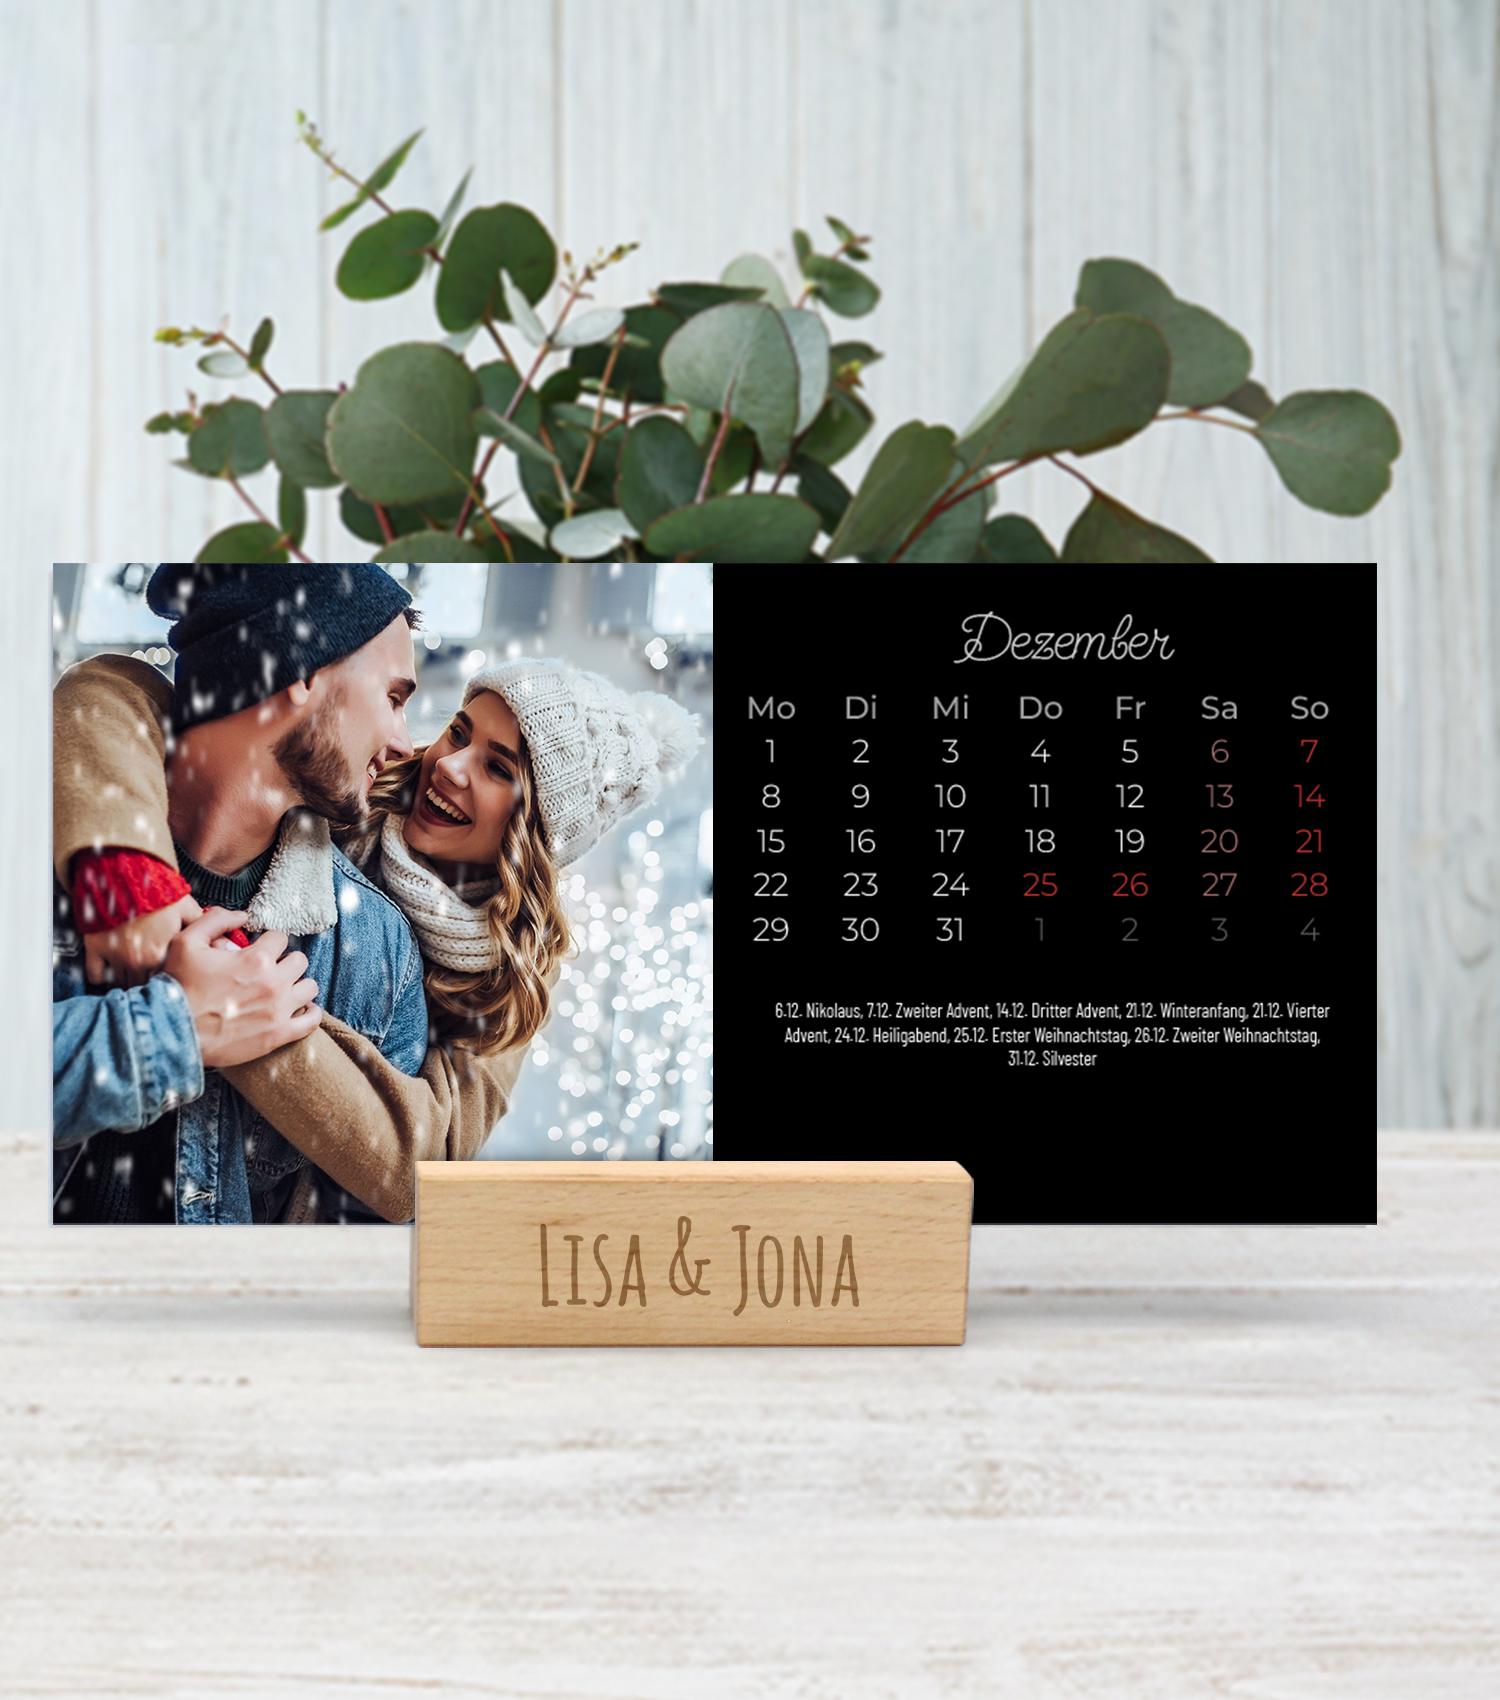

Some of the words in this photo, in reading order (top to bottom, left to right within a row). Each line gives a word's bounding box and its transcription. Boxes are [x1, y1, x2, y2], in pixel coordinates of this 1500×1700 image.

[954, 611, 1175, 663] Dezember
[749, 696, 795, 719] Mo
[846, 694, 876, 719] Di
[934, 694, 969, 719] Mi
[1020, 696, 1063, 719] Do
[1117, 696, 1146, 719] Fr
[1202, 696, 1237, 720] Sa
[1291, 696, 1329, 720] So
[765, 739, 774, 763] 1
[852, 739, 869, 763] 2
[942, 739, 959, 763] 3
[1031, 739, 1051, 763] 4
[1122, 739, 1139, 763] 5
[1211, 739, 1229, 763] 6
[1301, 739, 1318, 763] 7
[762, 784, 781, 808] 8
[851, 784, 870, 808] 9
[934, 784, 966, 808] 10
[1029, 784, 1049, 808] 11
[1115, 784, 1144, 808] 12
[1206, 784, 1234, 808] 13
[1294, 784, 1326, 808] 14
[757, 829, 785, 853] 15
[845, 829, 876, 853] 16
[935, 829, 965, 853] 17
[1025, 829, 1056, 853] 18
[1115, 829, 1145, 853] 19
[1201, 829, 1238, 853] 20
[1296, 829, 1321, 853] 21
[754, 872, 788, 896] 22
[843, 872, 878, 896] 23
[932, 872, 970, 896] 24
[1023, 872, 1058, 896] 25
[1112, 872, 1149, 896] 26
[1202, 872, 1237, 896] 27
[1291, 872, 1328, 896] 28
[753, 917, 789, 941] 29
[842, 917, 879, 941] 30
[936, 917, 962, 941] 31
[1035, 918, 1043, 941] 1
[1122, 918, 1138, 941] 2
[1212, 918, 1227, 941] 3
[1301, 918, 1320, 941] 4
[776, 1003, 802, 1018] 6.12.
[807, 1003, 863, 1019] Nikolaus,
[867, 1003, 892, 1018] 7.12.
[896, 1003, 943, 1018] Zweiter
[946, 1003, 992, 1019] Advent,
[996, 1003, 1027, 1018] 14.12.
[1032, 1003, 1072, 1018] Dritter
[1076, 1003, 1121, 1019] Advent,
[1126, 1003, 1156, 1018] 21.12.
[1160, 1003, 1248, 1022] Winteranfang,
[1253, 1003, 1283, 1018] 21.12.
[1287, 1003, 1330, 1018] Vierter
[785, 1027, 831, 1044] Advent,
[835, 1027, 869, 1043] 24.12.
[874, 1027, 950, 1047] Heiligabend,
[954, 1027, 988, 1043] 25.12.
[993, 1027, 1031, 1043] Erster
[1034, 1027, 1131, 1047] Weihnachtstag,
[1135, 1027, 1169, 1042] 26.12.
[1173, 1027, 1220, 1043] Zweiter
[1223, 1027, 1320, 1047] Weihnachtstag,
[1009, 1050, 1039, 1066] 31.12.
[1043, 1050, 1097, 1066] Silvester
[668, 1216, 711, 1296] &
